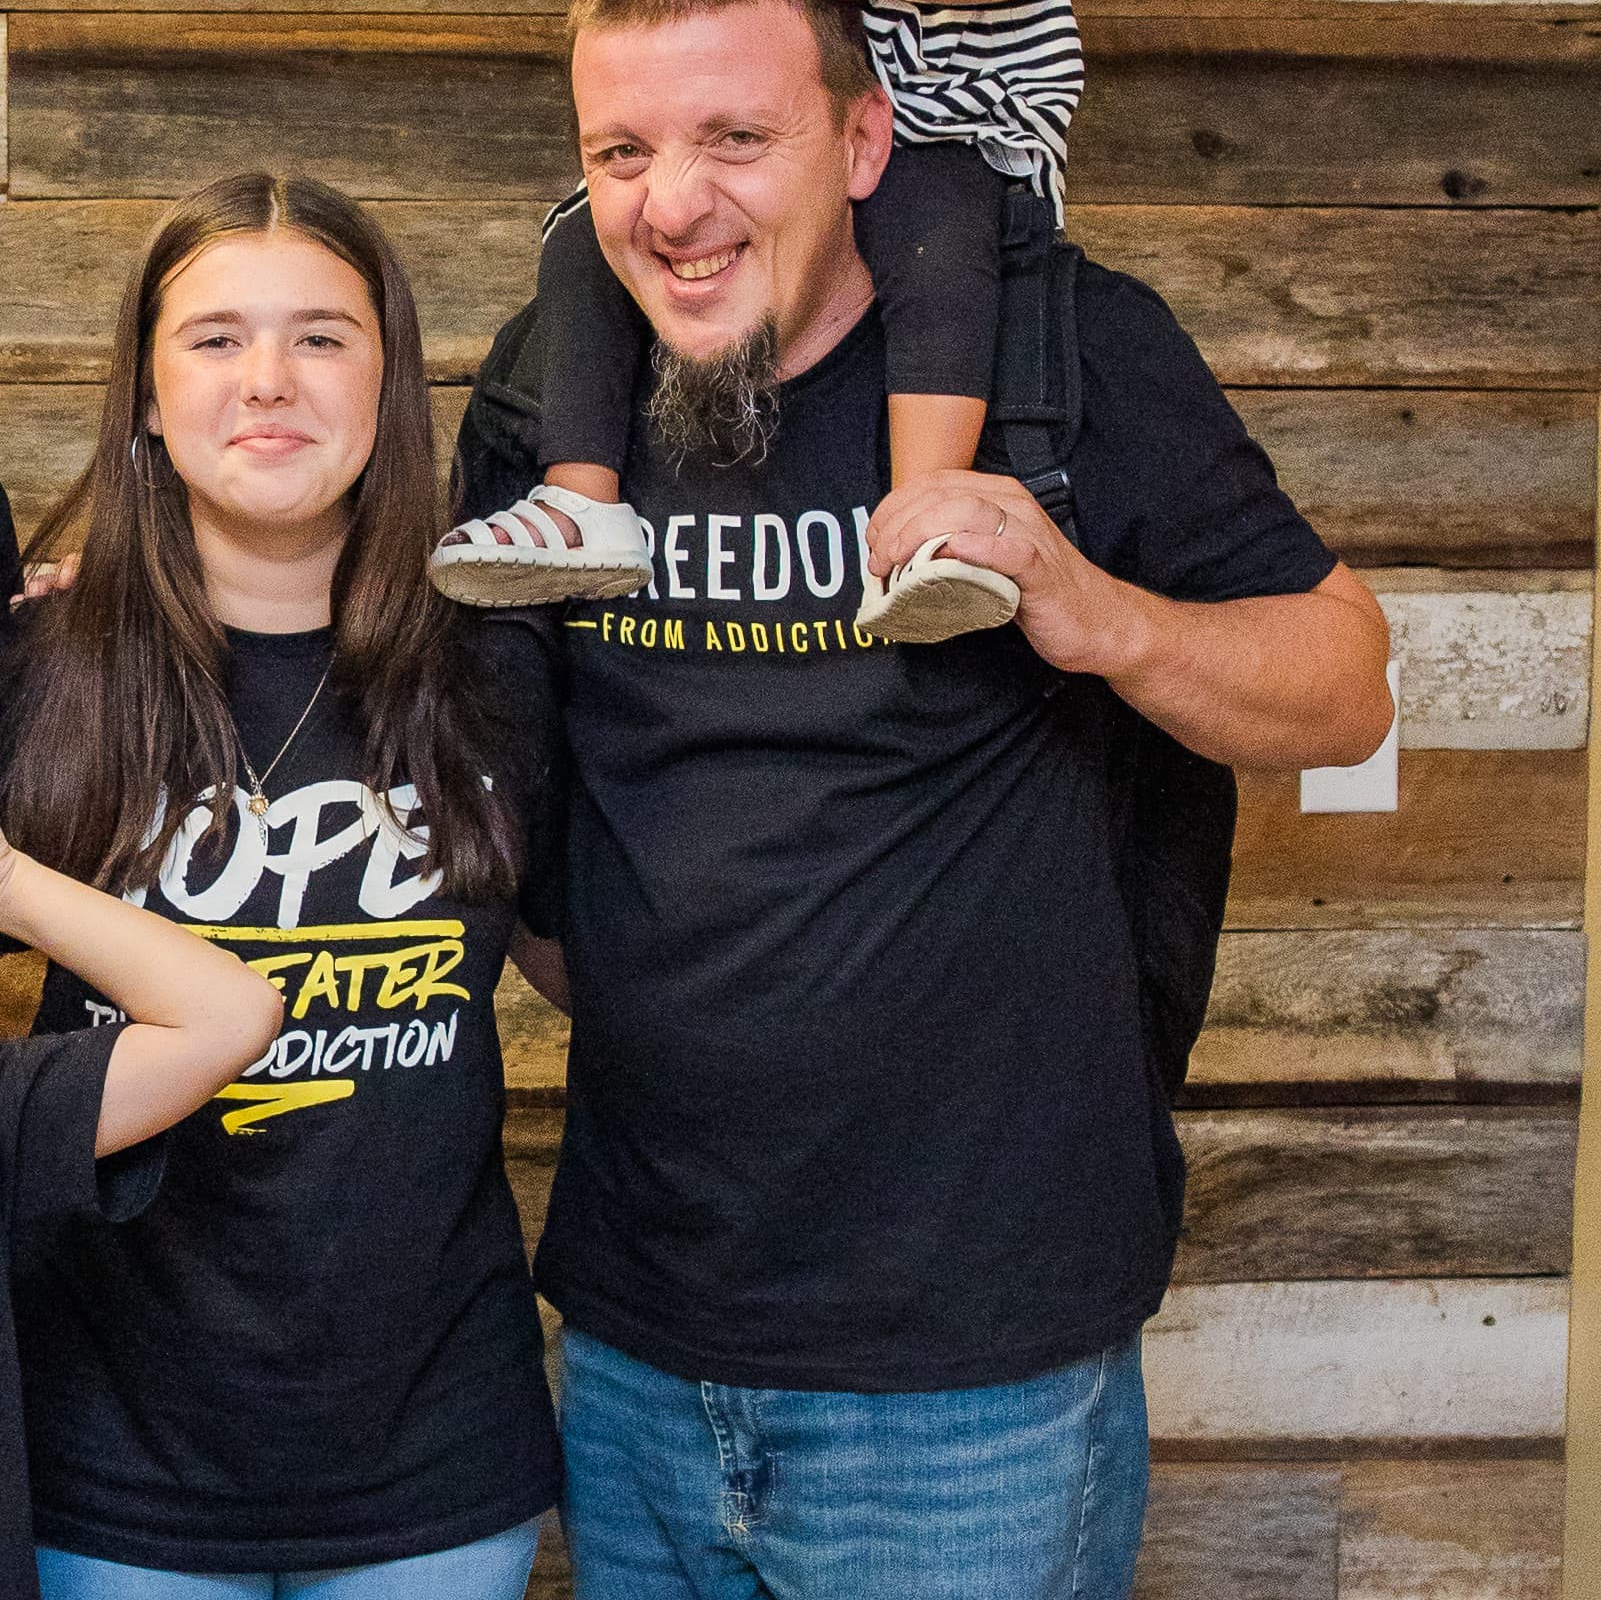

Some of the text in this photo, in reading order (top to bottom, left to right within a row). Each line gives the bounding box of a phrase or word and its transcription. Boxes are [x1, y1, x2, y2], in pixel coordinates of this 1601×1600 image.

[628, 506, 874, 601] EEDO
[603, 612, 888, 653] FROM ADDICTIO
[121, 775, 494, 931] OPE
[245, 938, 471, 1020] EATER
[240, 1008, 459, 1078] DICTION
